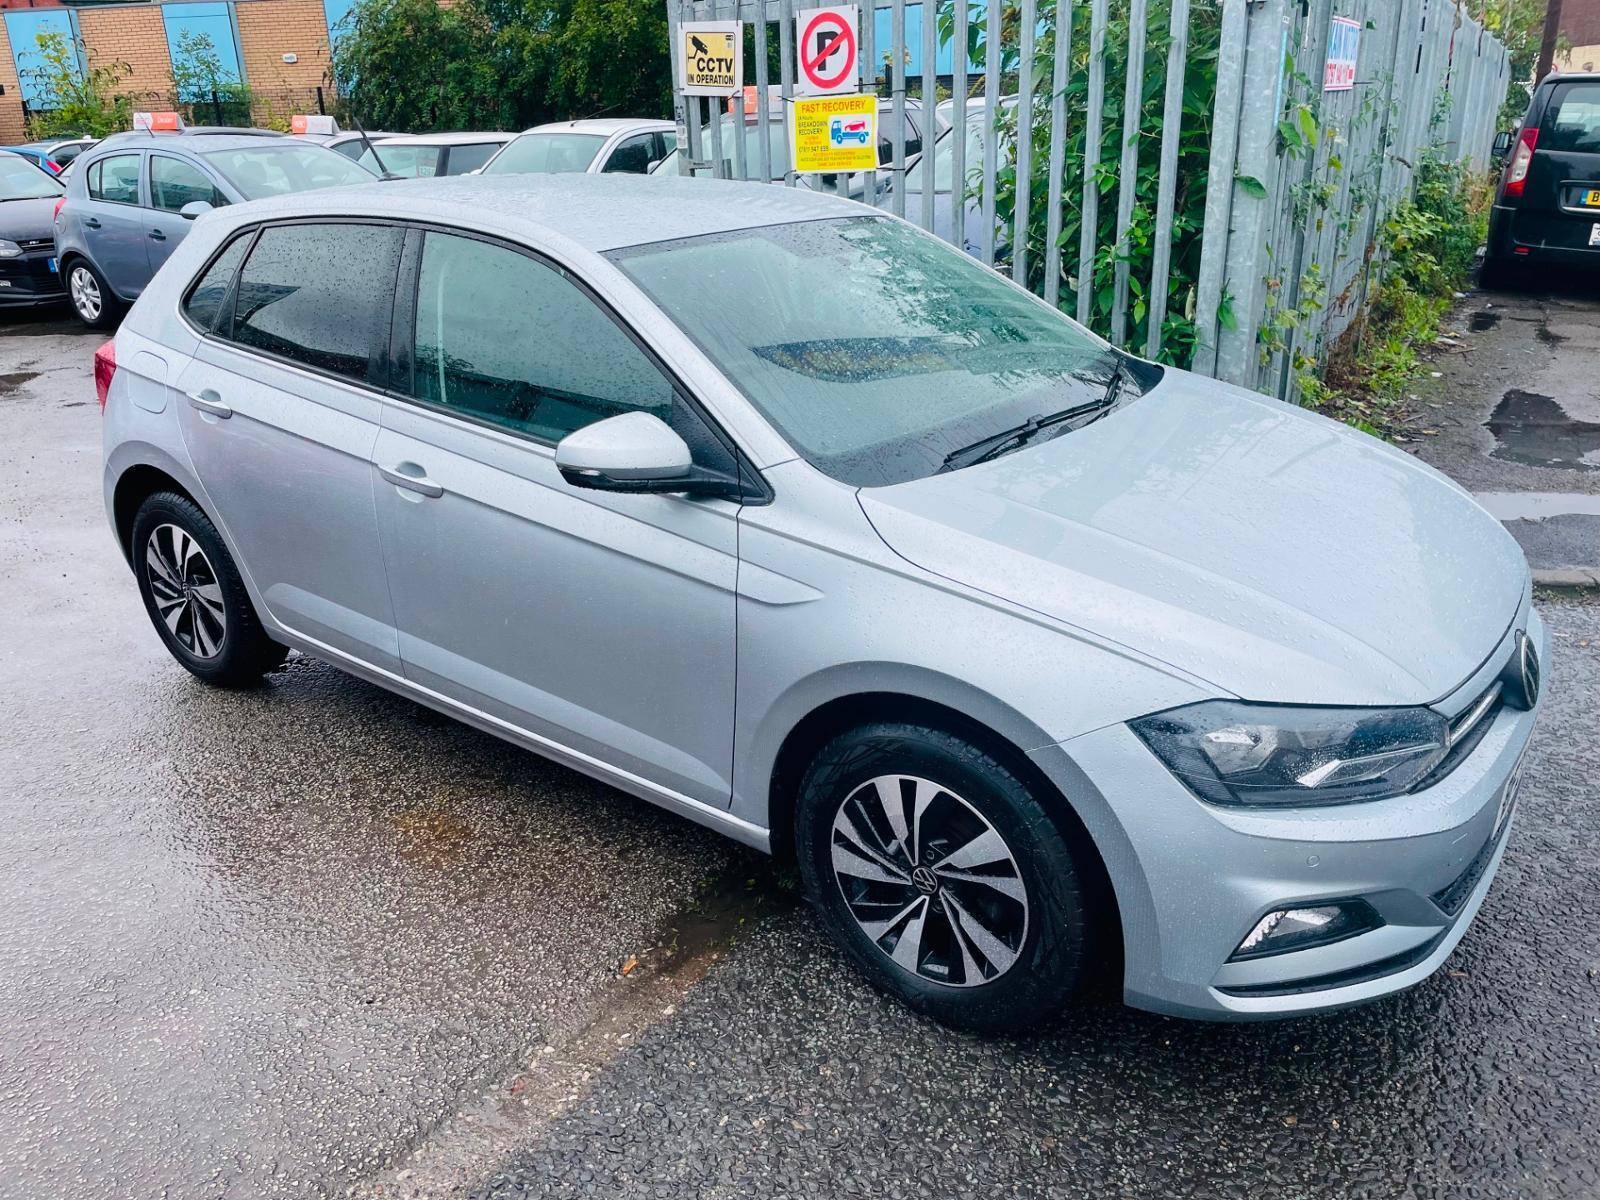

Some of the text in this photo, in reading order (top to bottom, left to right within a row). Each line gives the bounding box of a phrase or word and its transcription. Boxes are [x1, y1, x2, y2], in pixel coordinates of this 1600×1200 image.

[816, 31, 841, 72] P
[696, 57, 734, 73] CCTV
[687, 74, 734, 85] IN OPERATION
[801, 100, 866, 114] FAST RECOVERY
[798, 120, 828, 128] BREAKDOWN
[798, 128, 823, 136] RECOVERY
